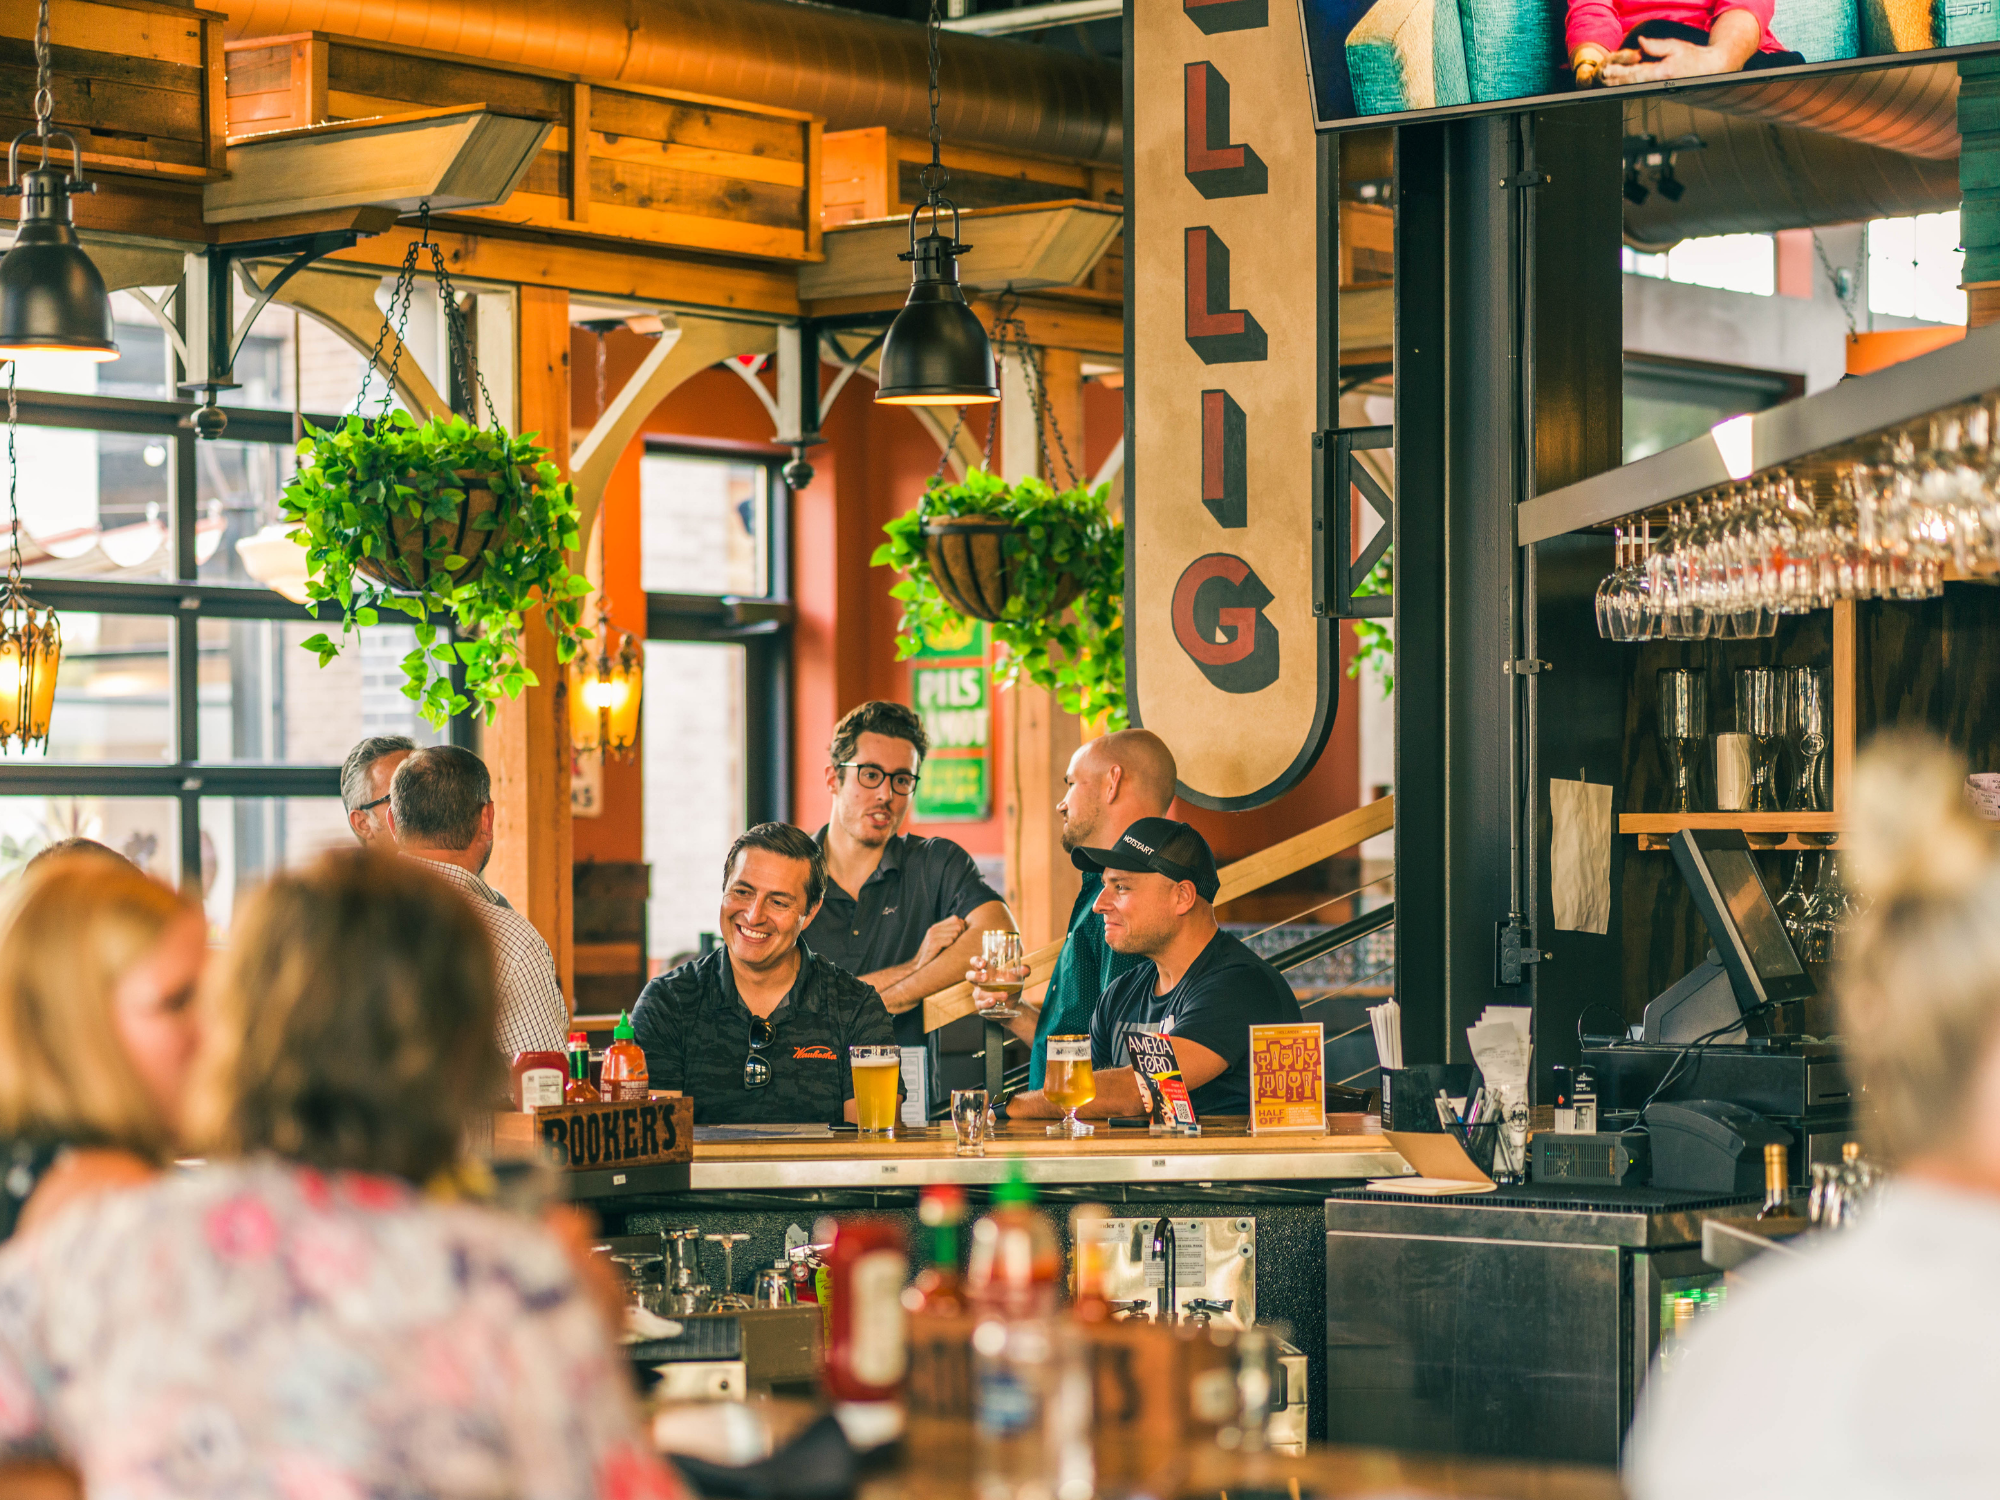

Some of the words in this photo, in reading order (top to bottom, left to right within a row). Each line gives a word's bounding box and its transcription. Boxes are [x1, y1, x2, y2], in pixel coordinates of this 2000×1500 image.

[1946, 1, 1991, 17] ESPN
[1171, 0, 1279, 693] LLIG
[918, 669, 981, 707] PILS
[1122, 834, 1155, 856] HOTSTART
[1128, 1035, 1173, 1056] AMELIA
[1258, 1045, 1316, 1065] HAPPY
[1264, 1073, 1312, 1092] HOUR
[1258, 1108, 1285, 1117] HALF
[1259, 1116, 1284, 1125] OFF
[542, 1103, 678, 1167] BOOKER'S
